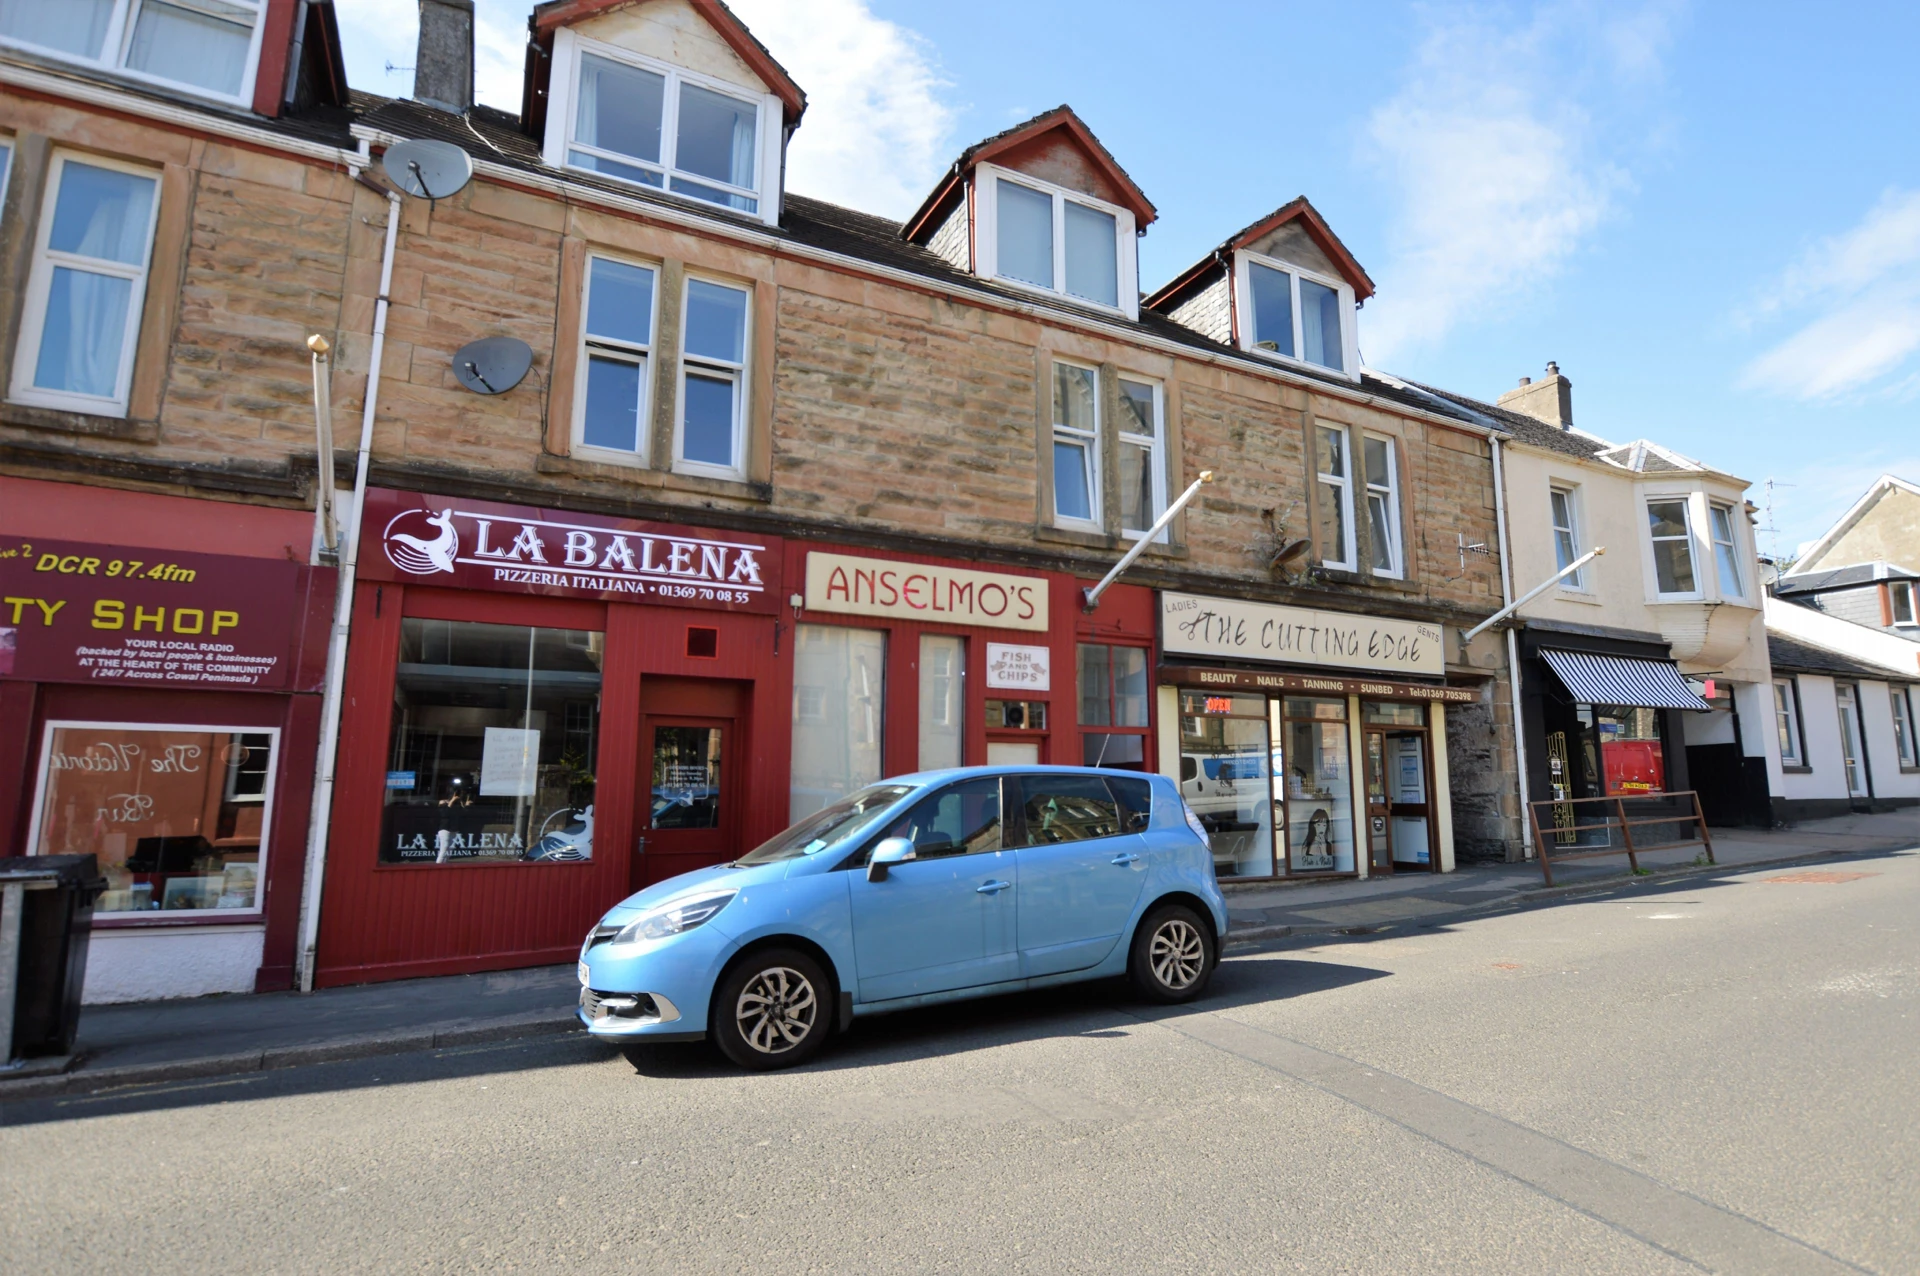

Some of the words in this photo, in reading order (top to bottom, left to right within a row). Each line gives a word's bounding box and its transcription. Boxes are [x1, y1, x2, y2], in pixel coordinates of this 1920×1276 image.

[22, 544, 33, 558] 2
[473, 519, 549, 564] LA
[564, 530, 764, 585] BALENA
[36, 553, 101, 575] DCR
[105, 560, 197, 583] 97.4fm
[494, 568, 569, 587] PIZZERIA
[572, 576, 645, 594] ITALIANA
[659, 585, 696, 599] 01369
[699, 589, 714, 600] 70
[716, 590, 732, 602] 08
[735, 592, 749, 603] 55
[827, 565, 1035, 620] ANSELMO'S
[1165, 599, 1198, 613] LADIES
[4, 597, 67, 627] TY
[91, 599, 240, 635] SHOP
[1203, 610, 1247, 646] THE
[1261, 619, 1359, 658] CUTTING
[1368, 629, 1420, 662] EDGE
[1417, 625, 1440, 643] GENTS
[125, 639, 157, 649] YOUR
[160, 641, 197, 650] LOCAL
[200, 643, 234, 652] RADIO
[76, 646, 122, 656] (backed
[123, 649, 137, 658] by
[140, 650, 166, 658] local
[167, 652, 204, 661] people
[206, 653, 214, 661] &
[216, 654, 277, 665] businesses)
[1002, 651, 1032, 662] FISH
[79, 658, 95, 666] AT
[97, 659, 121, 667] THE
[123, 660, 161, 669] HEART
[164, 662, 180, 670] OF
[183, 663, 204, 671] THE
[206, 664, 271, 674] COMMUNITY
[125, 670, 163, 678] Across
[166, 672, 200, 680] Cowal
[201, 673, 251, 683] Peninsula
[998, 670, 1038, 682] CHIPS
[1201, 672, 1237, 684] BEAUTY
[1257, 676, 1284, 687] NAILS
[1302, 679, 1344, 691] TANNING
[1361, 683, 1393, 695] SUNBED
[1446, 690, 1472, 701] 705398
[1207, 697, 1231, 711] OPEN
[397, 833, 427, 849] LA
